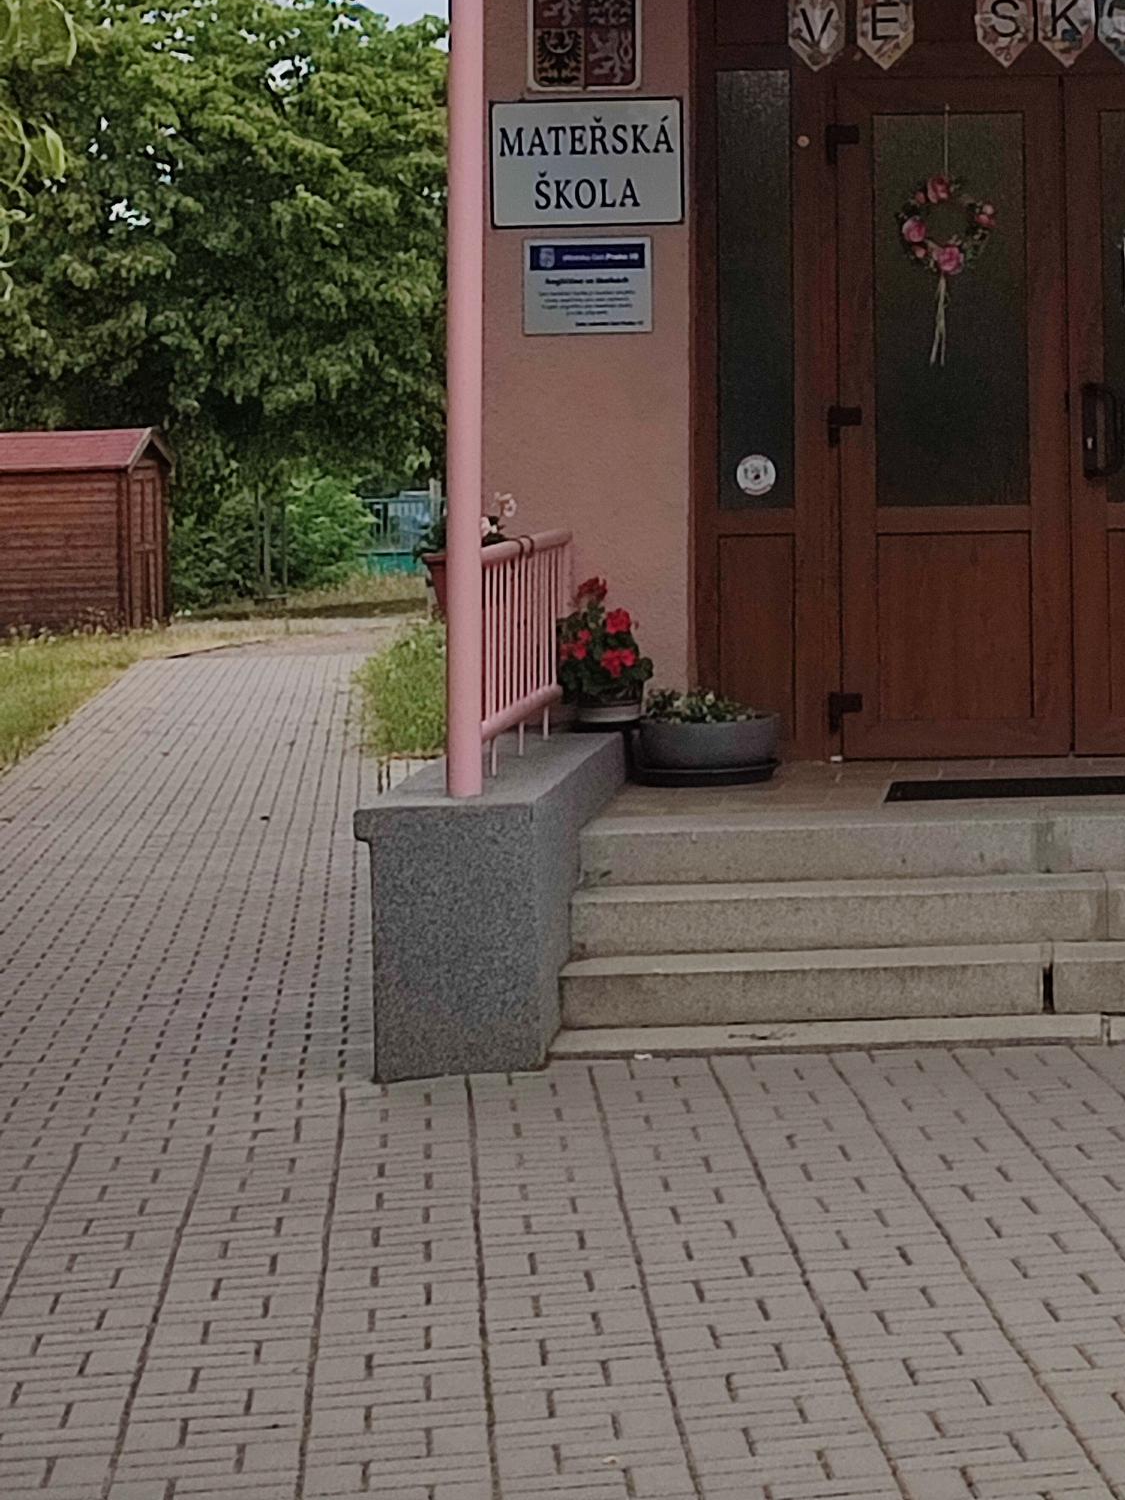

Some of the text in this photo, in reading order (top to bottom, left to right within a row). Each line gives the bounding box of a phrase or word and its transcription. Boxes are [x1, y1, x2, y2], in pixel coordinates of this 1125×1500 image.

[799, 2, 903, 44] VE
[499, 115, 675, 158] MATEŘSKÁ
[534, 171, 641, 211] ŠKOLA
